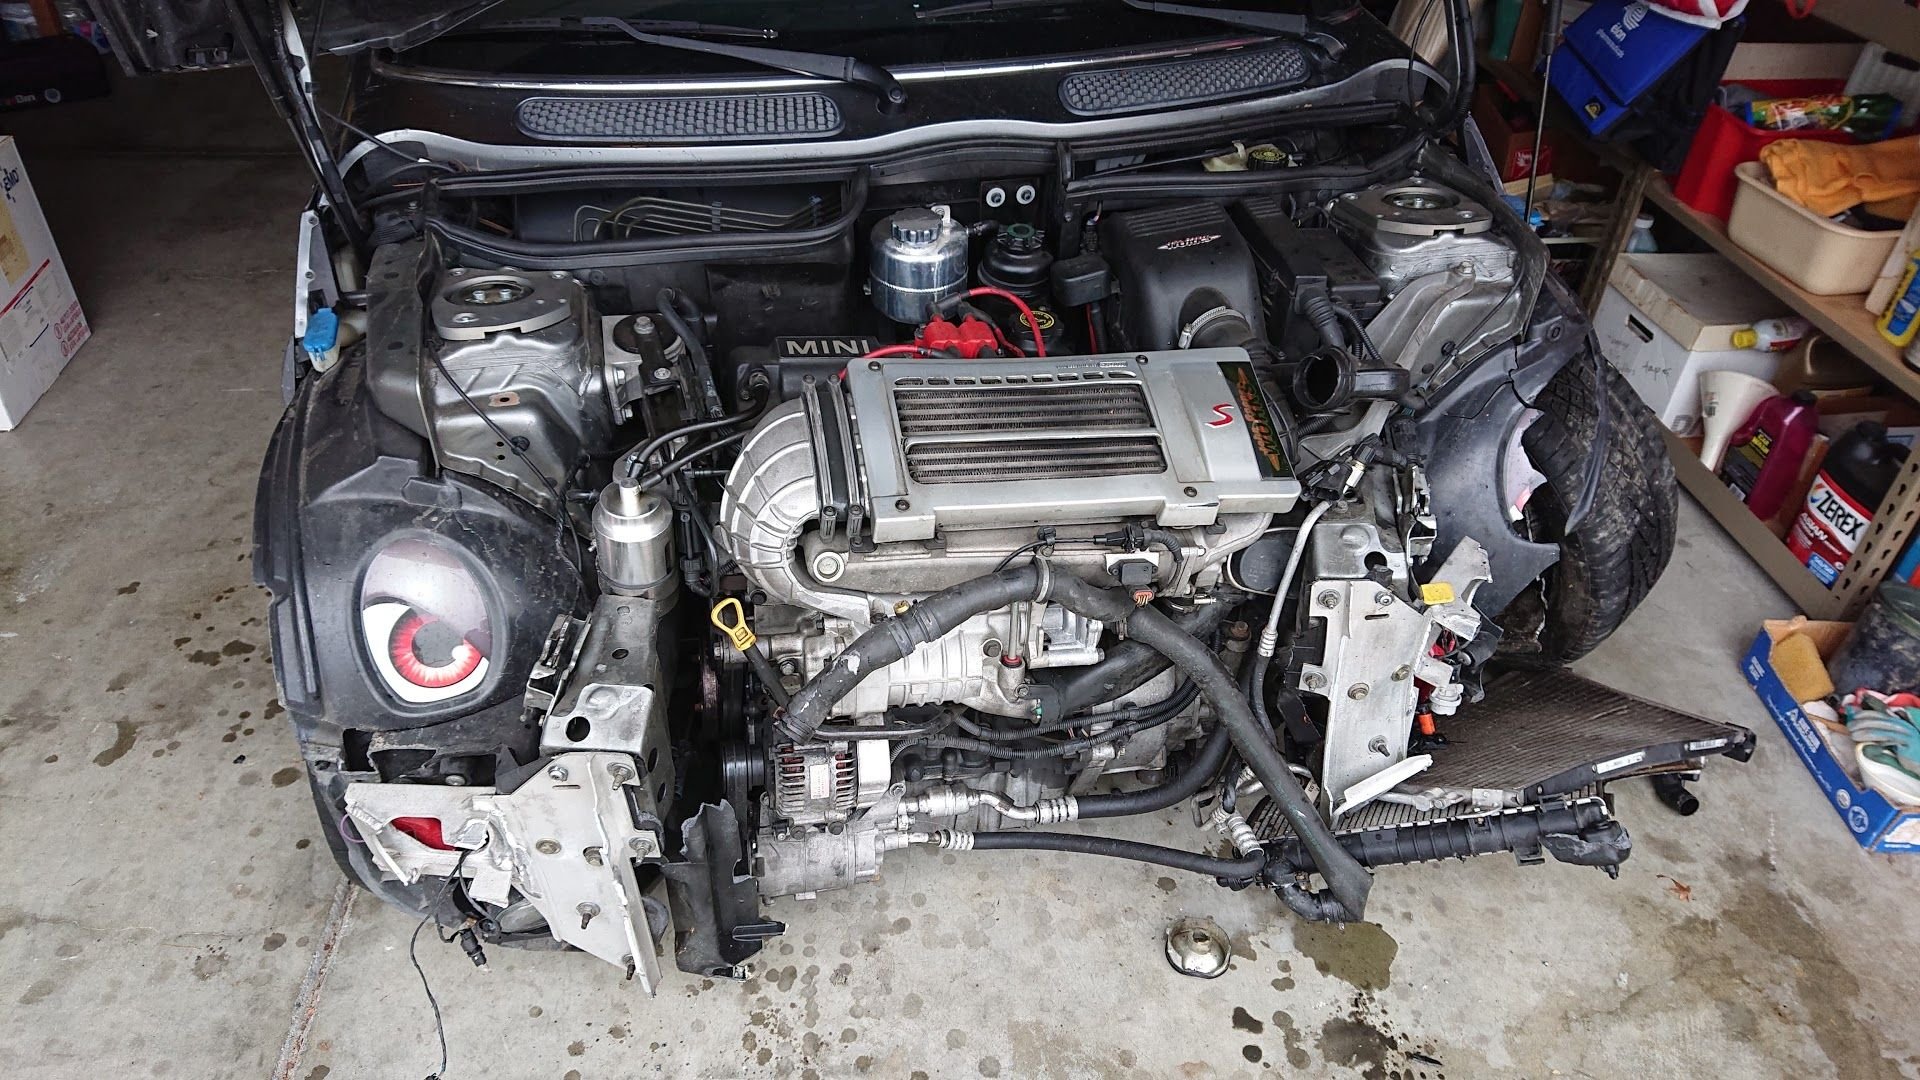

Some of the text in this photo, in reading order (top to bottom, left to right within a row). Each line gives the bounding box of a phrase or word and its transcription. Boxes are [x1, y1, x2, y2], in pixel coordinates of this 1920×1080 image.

[786, 339, 870, 355] MINI
[1204, 402, 1235, 429] S
[1800, 512, 1829, 541] ASIAN
[1816, 490, 1865, 541] ZEREX
